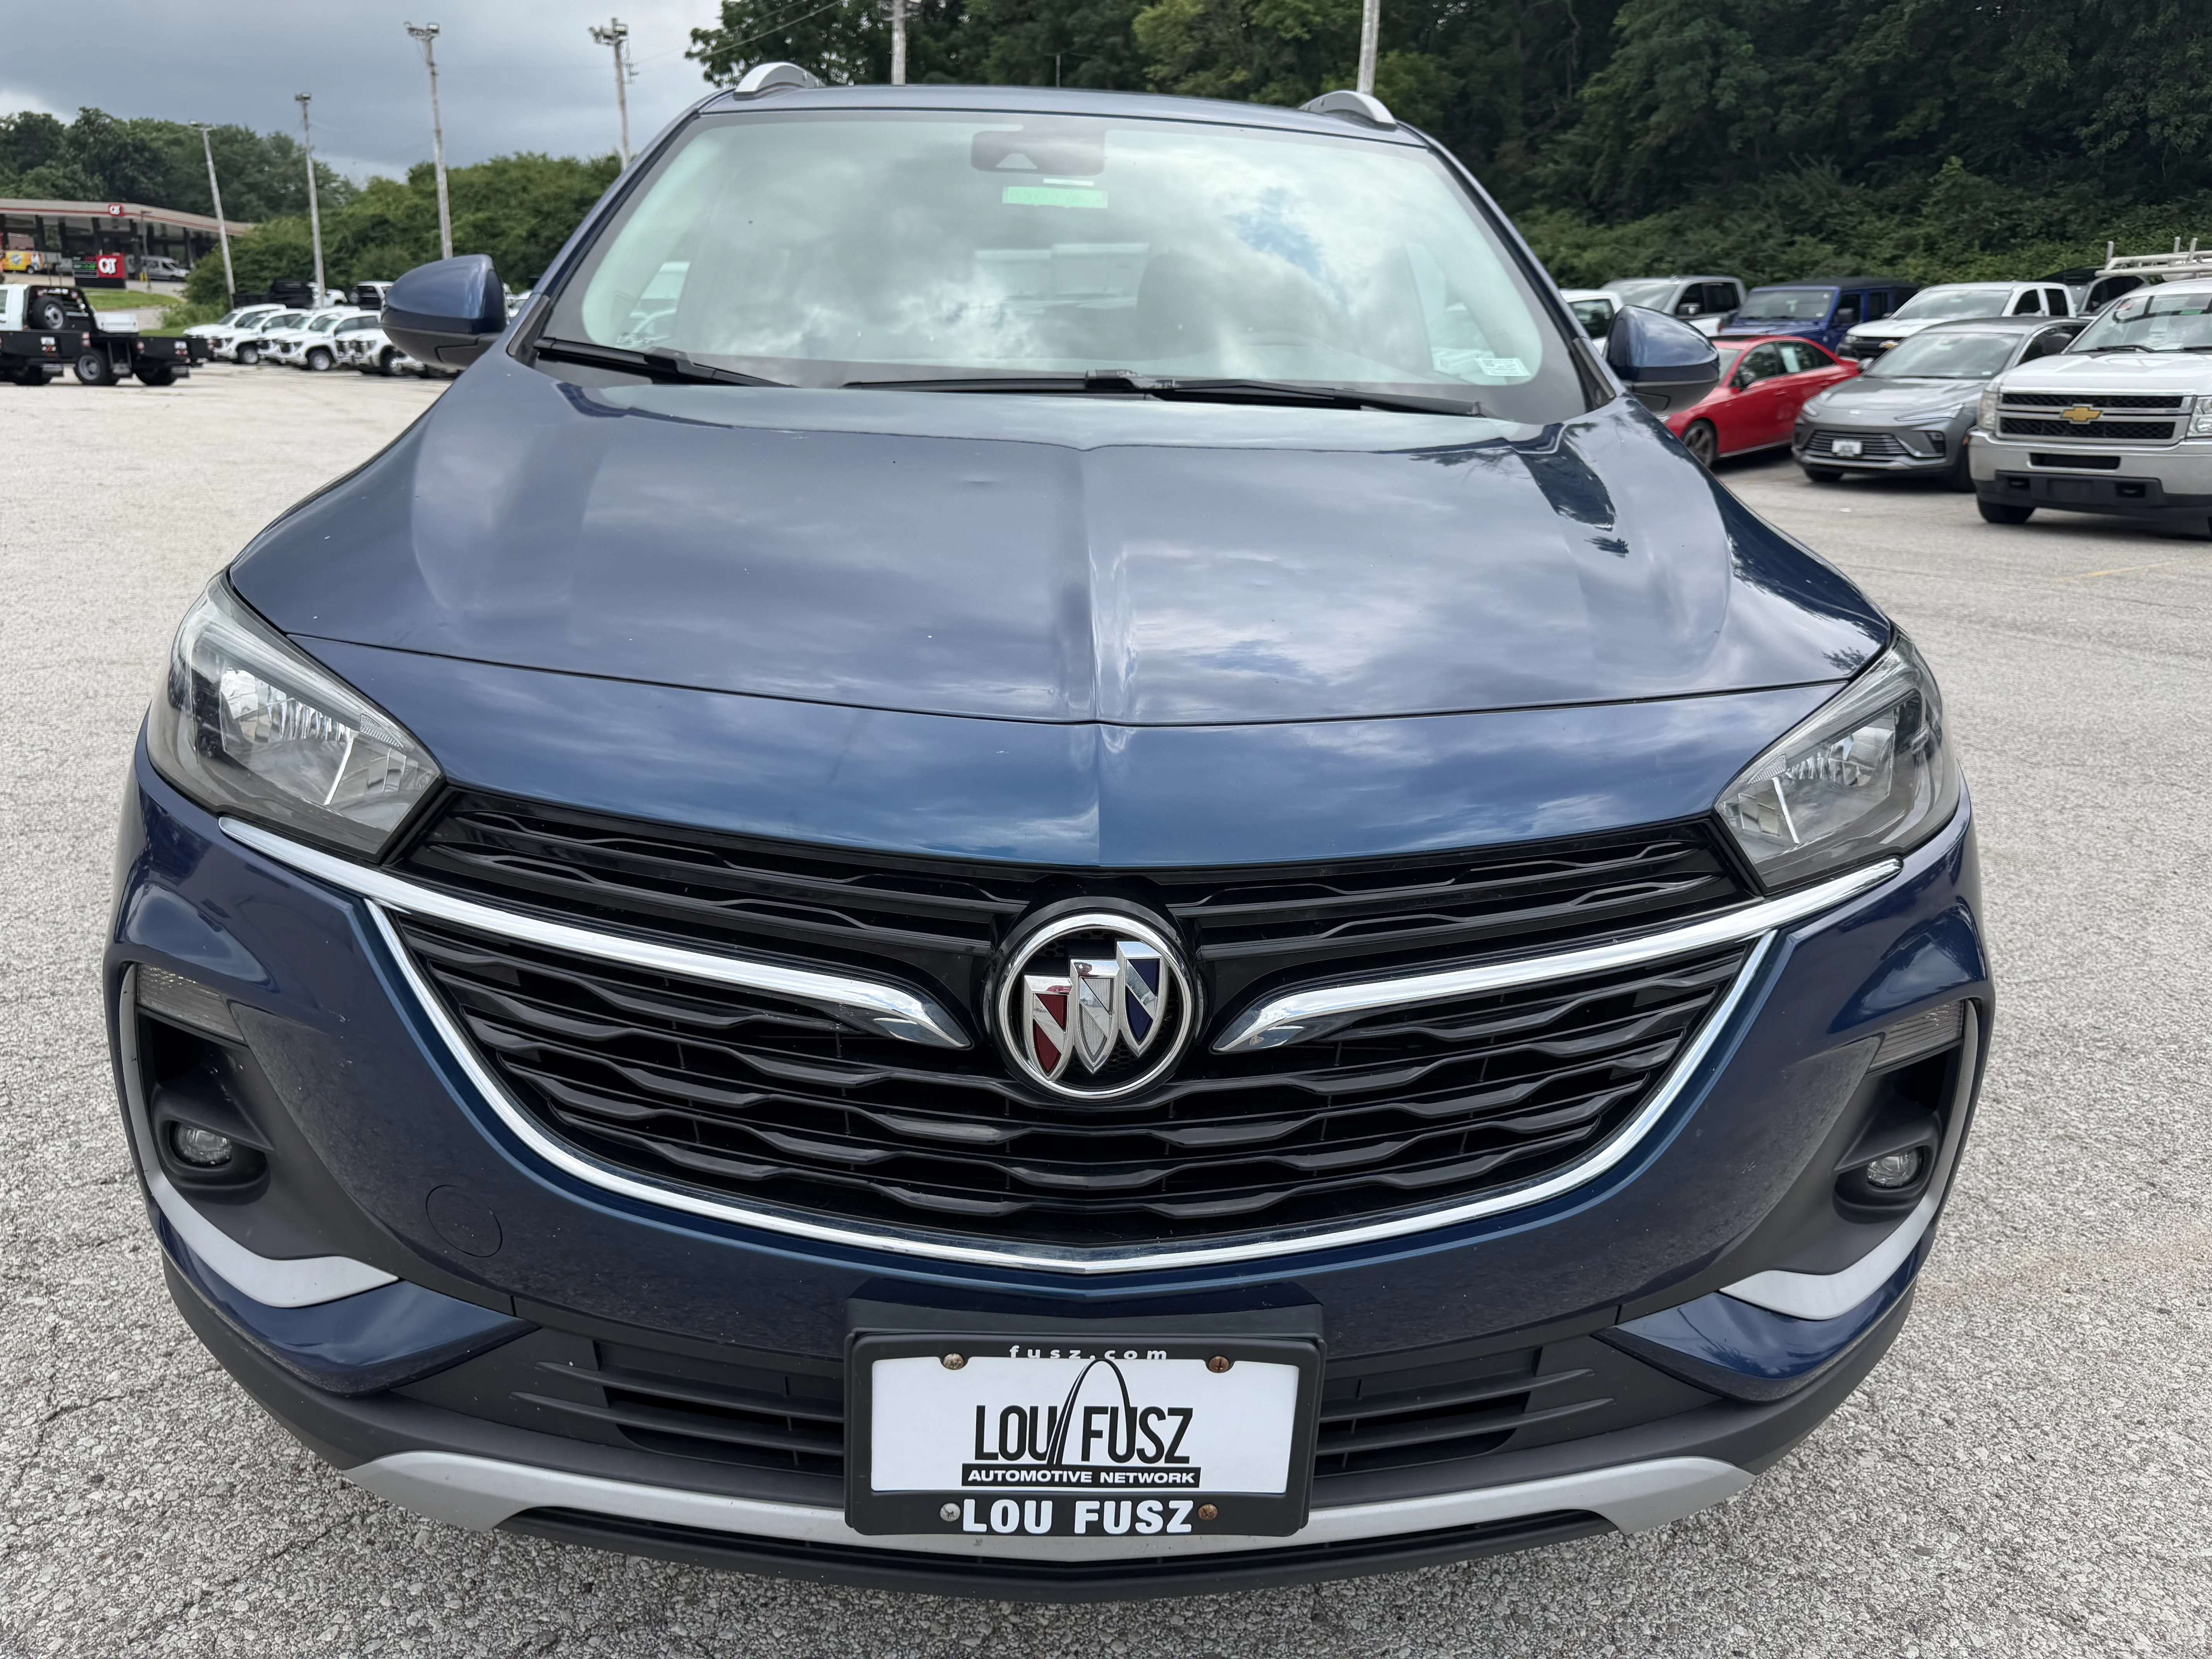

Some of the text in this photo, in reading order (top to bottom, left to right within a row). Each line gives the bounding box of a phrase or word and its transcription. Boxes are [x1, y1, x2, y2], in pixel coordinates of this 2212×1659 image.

[98, 258, 117, 274] QT
[1009, 1345, 1167, 1360] fusz.com
[974, 1405, 1194, 1464] LOU FUSZ
[967, 1470, 1195, 1484] AUTOMOTIVE NETWORK
[962, 1499, 1194, 1535] LOU FUSZ
